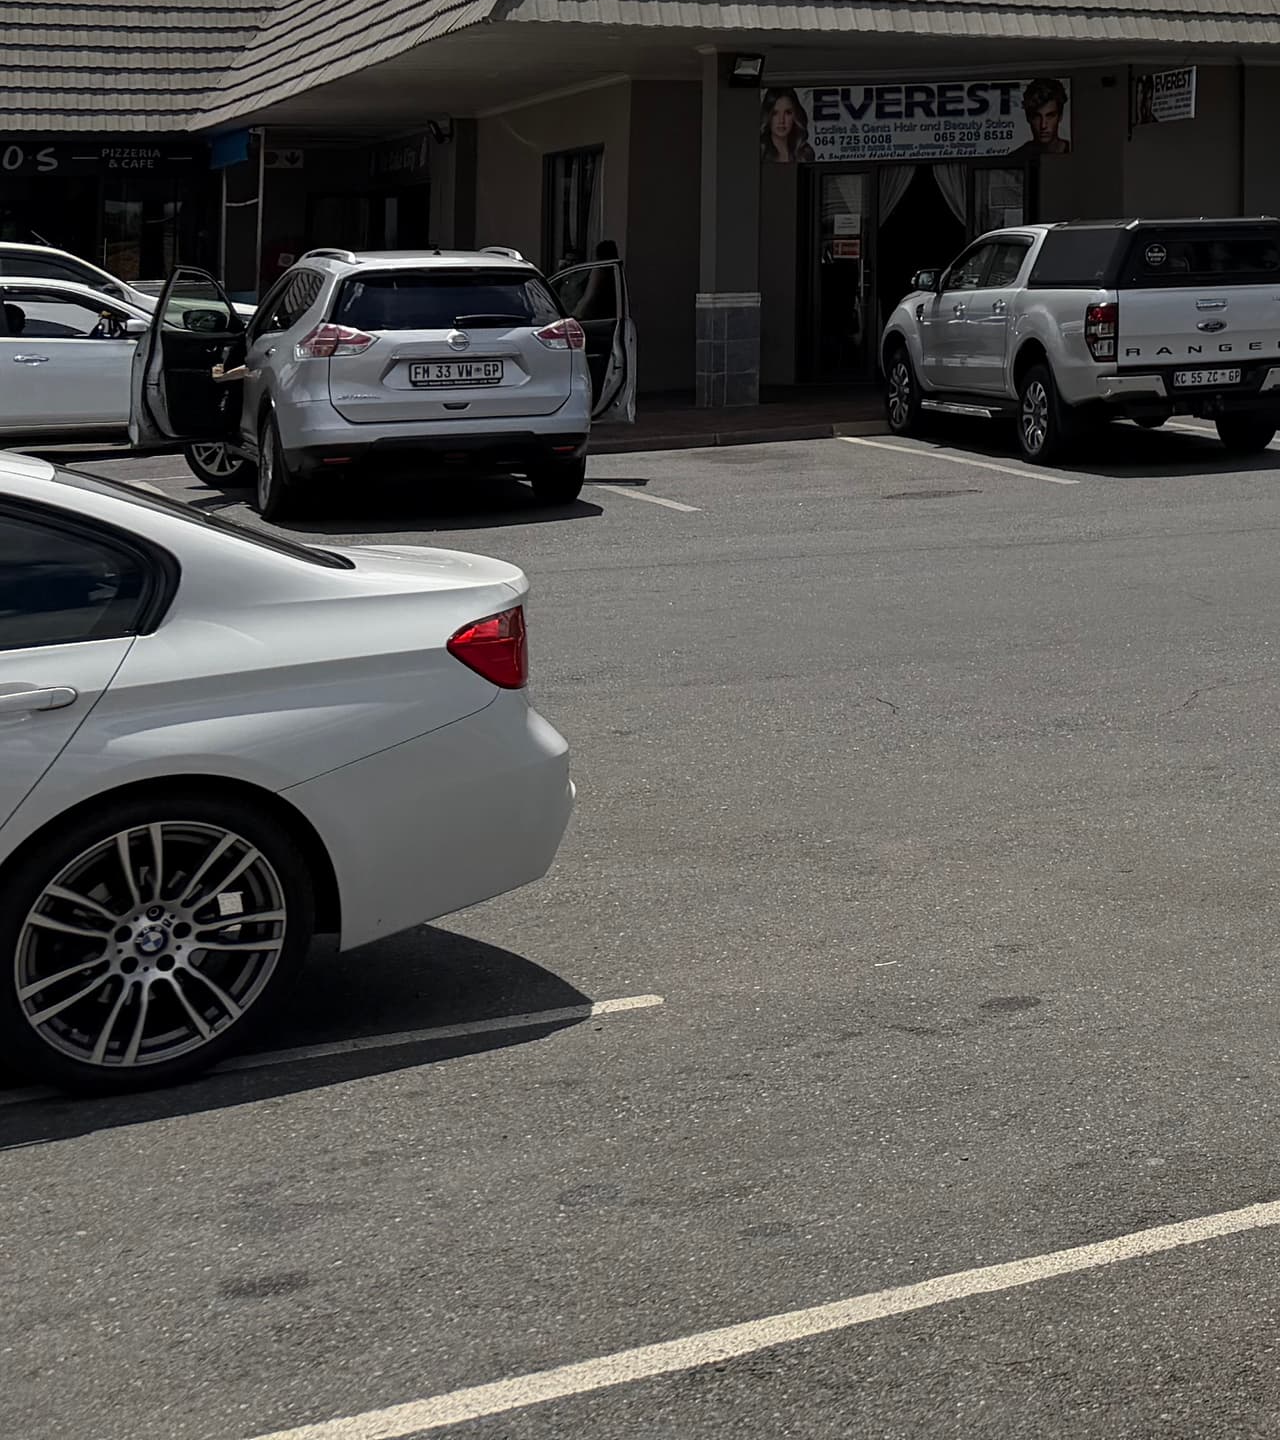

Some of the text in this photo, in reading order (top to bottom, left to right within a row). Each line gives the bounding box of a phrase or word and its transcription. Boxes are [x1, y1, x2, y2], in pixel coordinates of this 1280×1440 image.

[1155, 70, 1192, 92] EVEREST
[813, 82, 1020, 121] EVEREST
[814, 118, 1014, 134] Ladies & Gents Hair and Beauty Salon
[814, 133, 892, 146] 064 725 0008
[934, 129, 1013, 142] 065 209 8518
[101, 148, 161, 158] PIZZERIA
[109, 159, 154, 168] & CAFE
[414, 365, 430, 379] FM
[436, 365, 451, 378] 33
[483, 363, 499, 376] GP
[1175, 369, 1240, 384] KC 55 ZC GP
